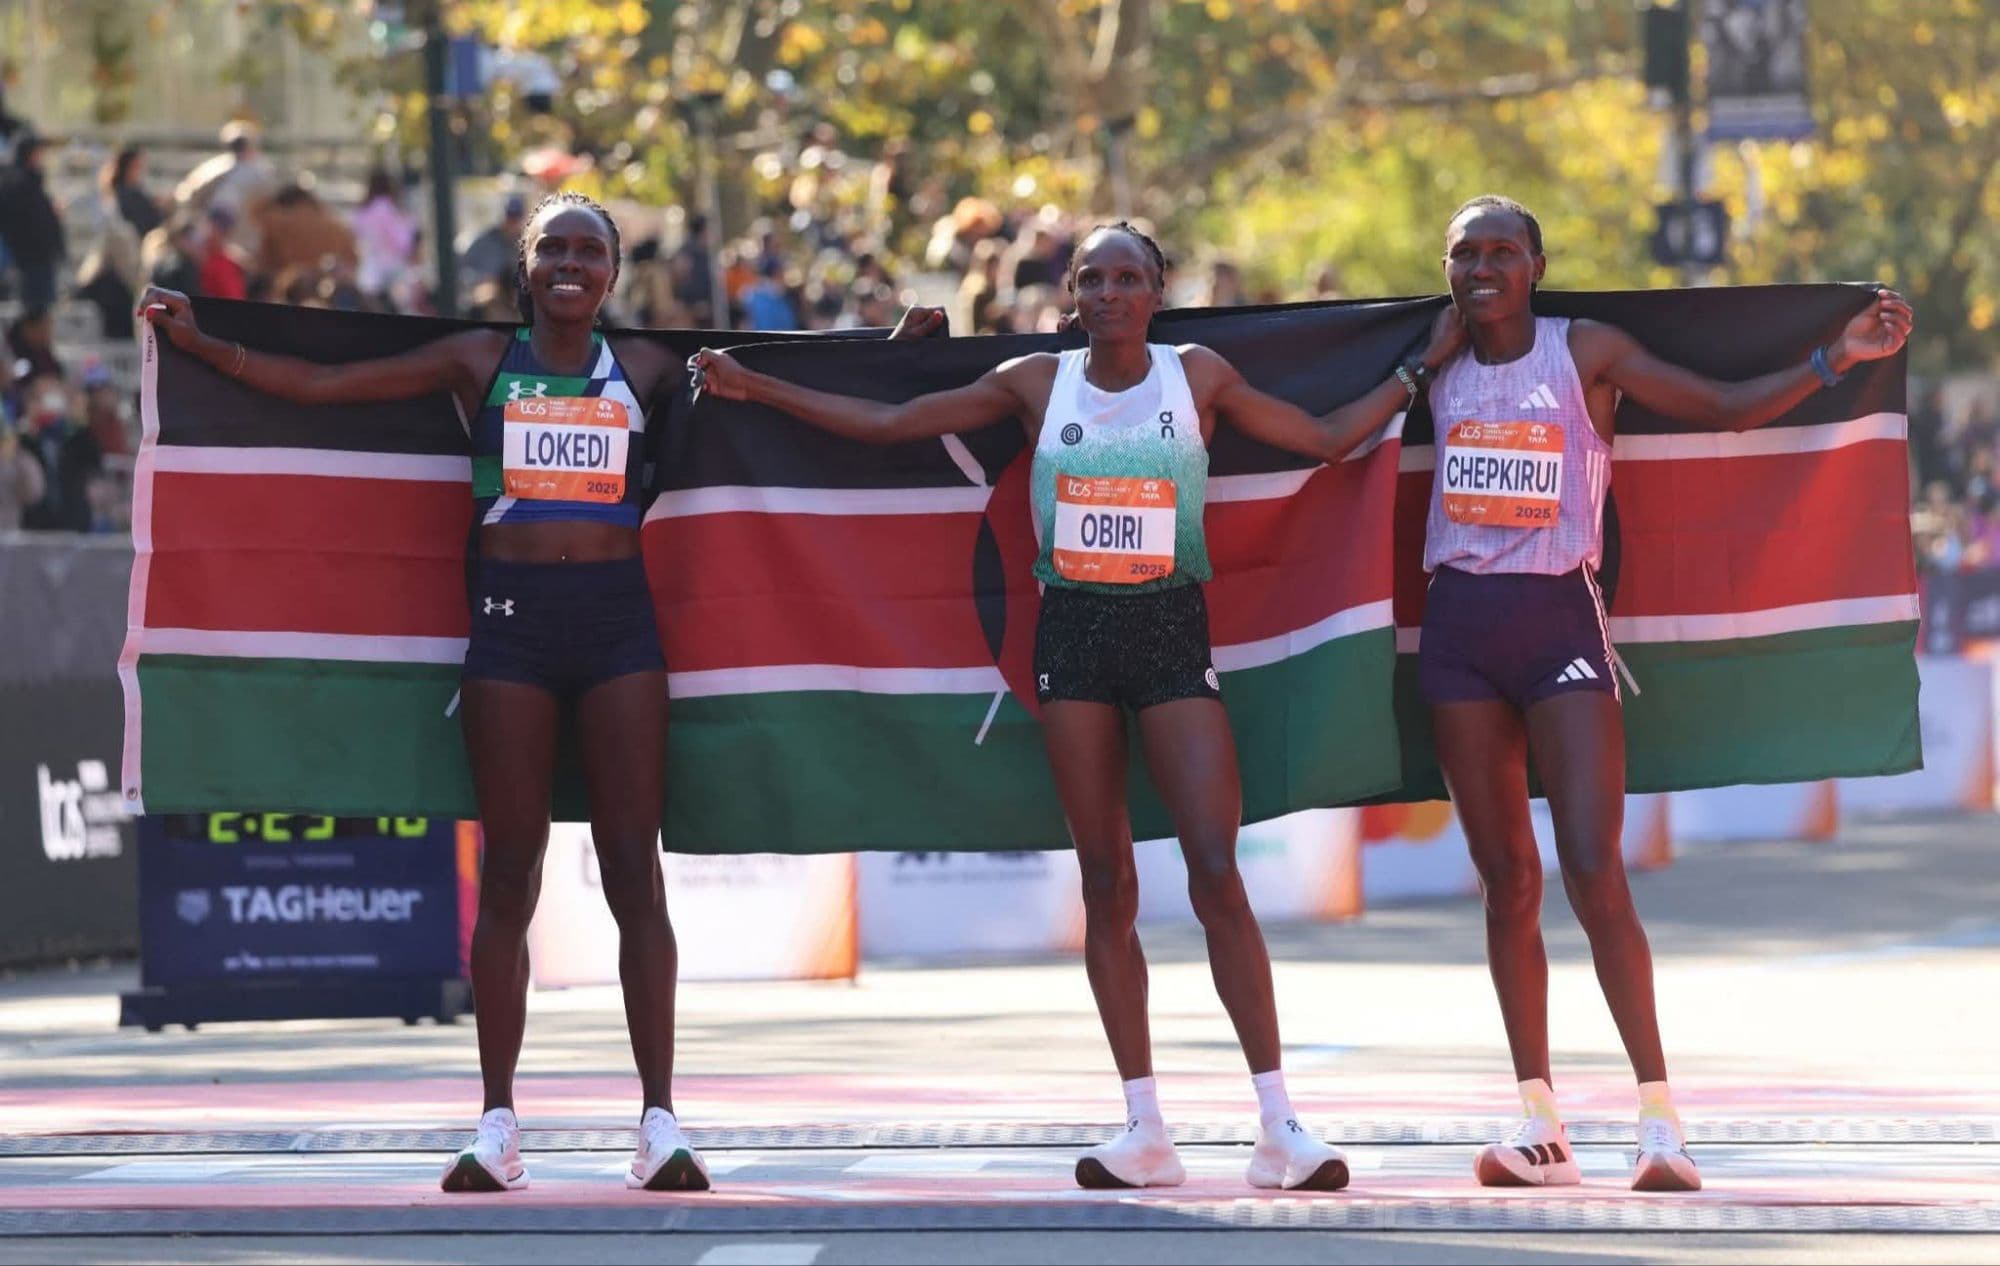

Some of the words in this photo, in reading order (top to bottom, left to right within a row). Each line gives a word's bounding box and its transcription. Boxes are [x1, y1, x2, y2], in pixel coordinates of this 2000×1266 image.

[524, 431, 610, 469] LOKEDI
[1446, 454, 1558, 494] CHEPKIRUI
[587, 480, 619, 494] 2025
[1067, 478, 1091, 497] tcs
[1515, 505, 1552, 519] 2025
[1080, 512, 1143, 550] OBIRI
[1130, 562, 1167, 576] 2025
